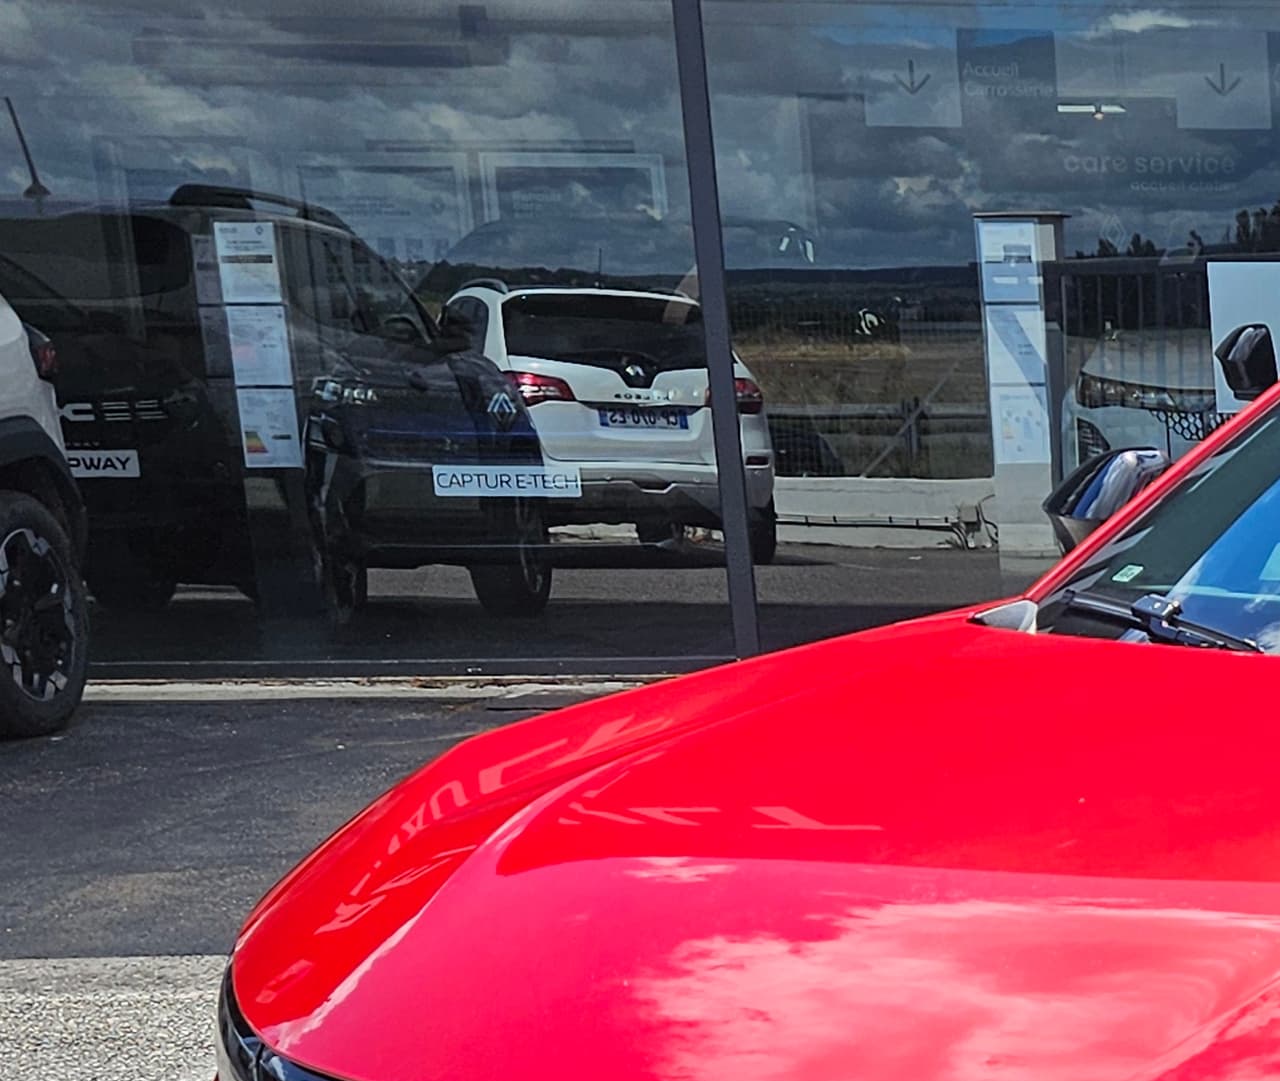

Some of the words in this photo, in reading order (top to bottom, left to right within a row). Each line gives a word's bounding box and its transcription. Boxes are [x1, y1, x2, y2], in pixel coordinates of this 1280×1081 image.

[962, 61, 1020, 78] Accueil
[1063, 154, 1128, 174] care
[1134, 152, 1236, 174] service
[68, 456, 131, 471] PWAY
[435, 472, 513, 490] CAPTUR
[516, 473, 579, 490] E-TECH
